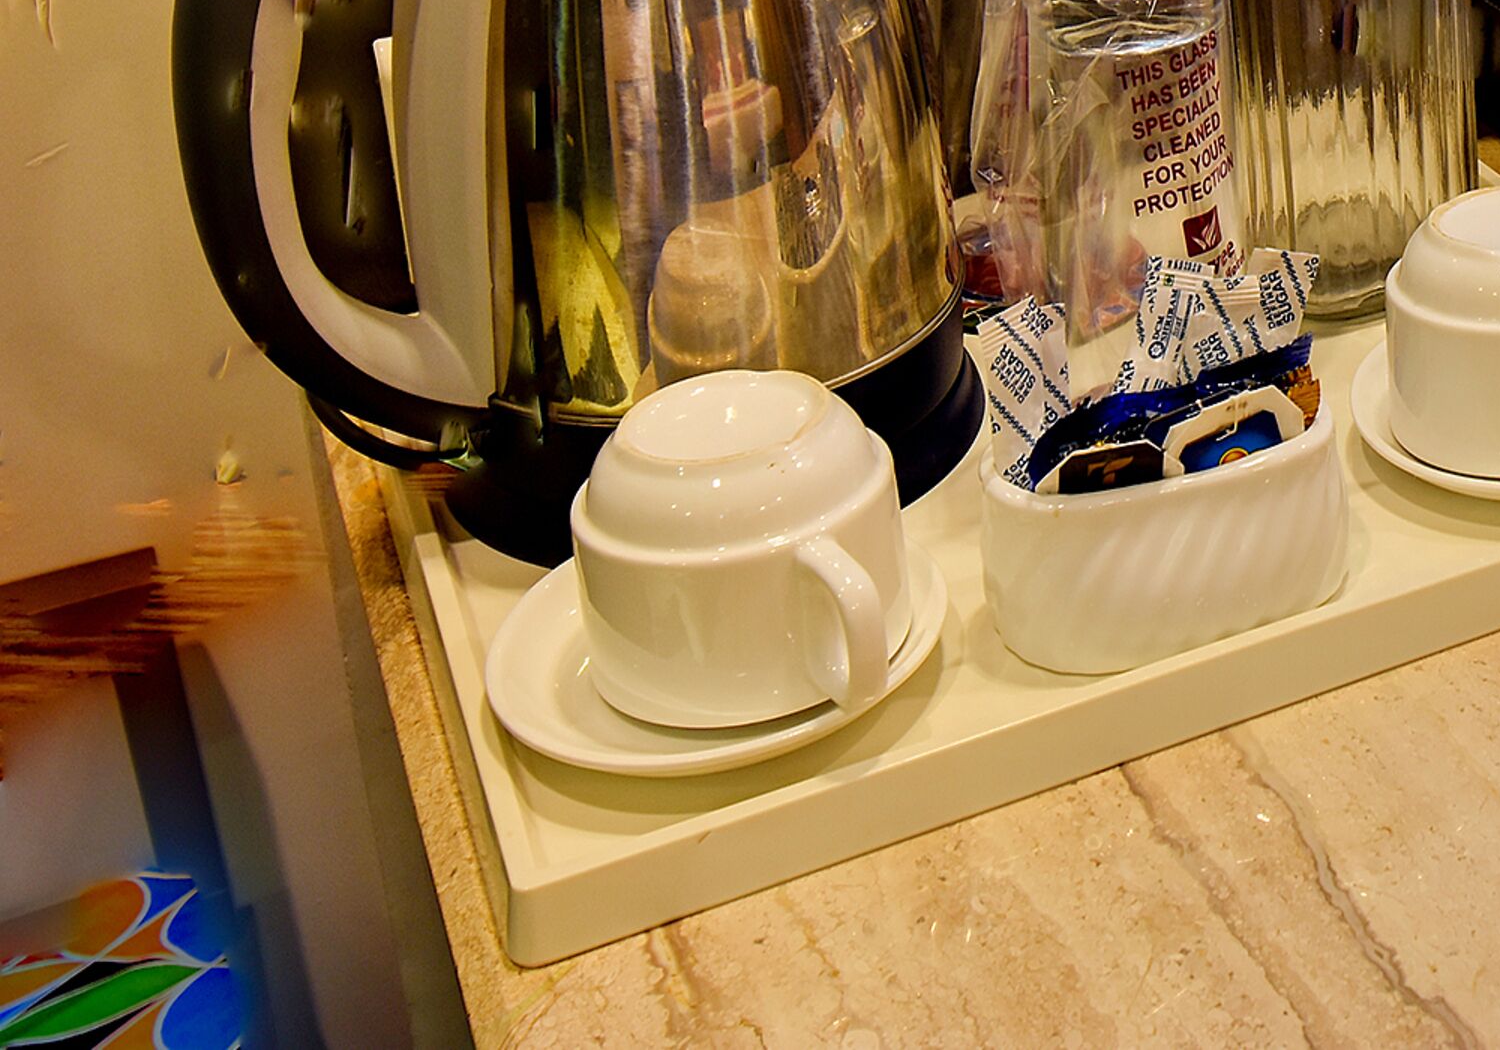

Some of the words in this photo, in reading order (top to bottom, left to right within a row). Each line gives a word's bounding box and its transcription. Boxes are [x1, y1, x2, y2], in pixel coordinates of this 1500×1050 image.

[1116, 60, 1164, 92] THIS
[1168, 29, 1218, 74] GLASS
[1131, 83, 1174, 115] HAS
[1178, 58, 1217, 99] BEEN
[1132, 81, 1221, 141] SPECIALLY
[1143, 111, 1221, 163] CLEANED
[1133, 151, 1235, 217] PROTECTION
[1142, 161, 1187, 189] FOR
[1190, 134, 1227, 176] YOUR
[1268, 270, 1296, 323] SUGAR
[990, 361, 1025, 404] DAURALA
[993, 355, 1031, 398] REFINED
[1001, 344, 1036, 388] SUGAR
